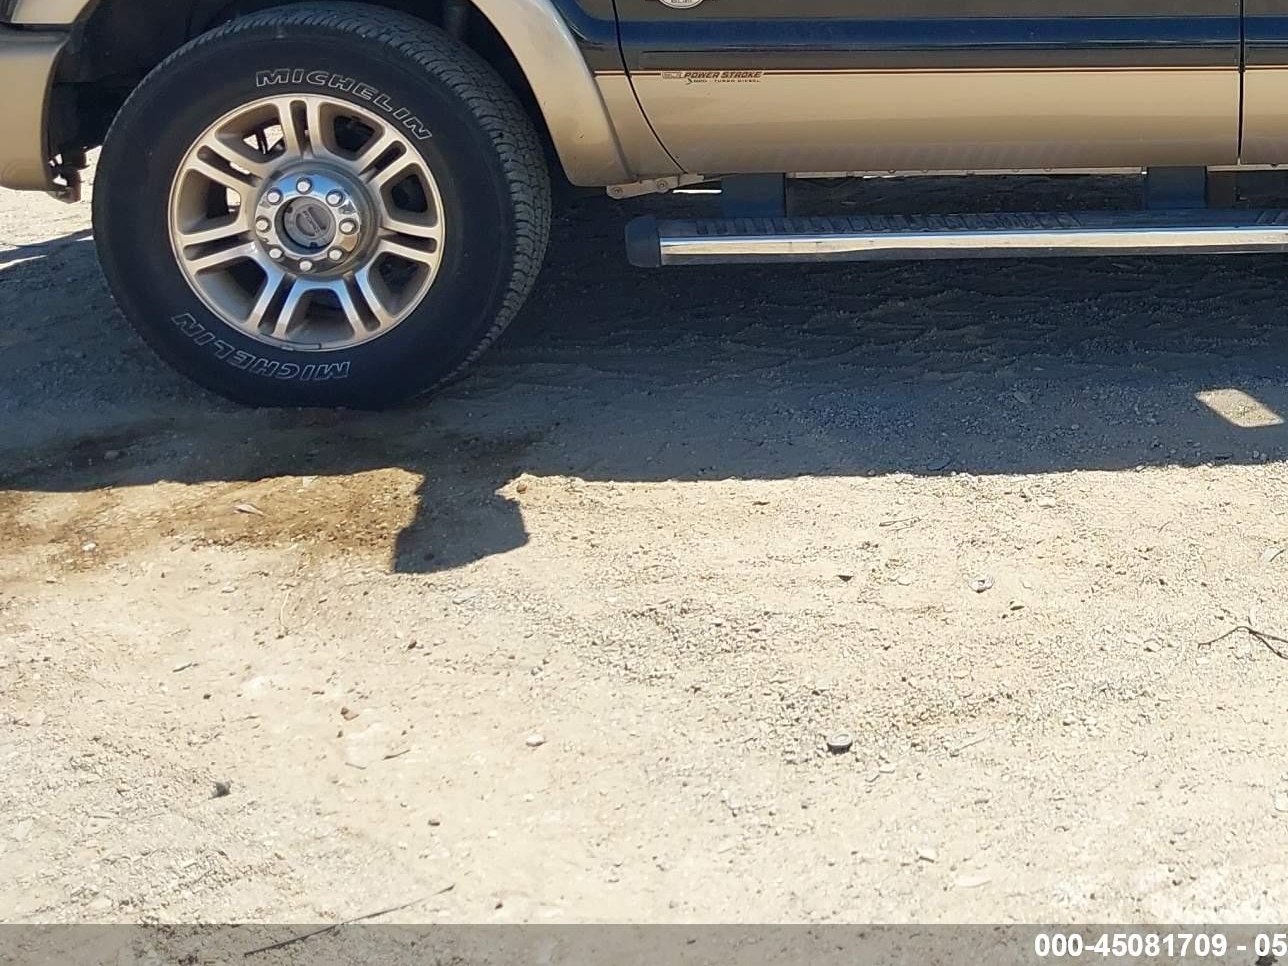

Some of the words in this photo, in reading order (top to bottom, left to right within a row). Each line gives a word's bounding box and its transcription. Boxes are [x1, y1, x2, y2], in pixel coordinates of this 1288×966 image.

[256, 67, 431, 141] MICHELIN
[684, 71, 719, 79] POWER
[720, 71, 762, 79] STROKE
[171, 311, 351, 381] MICHELIN
